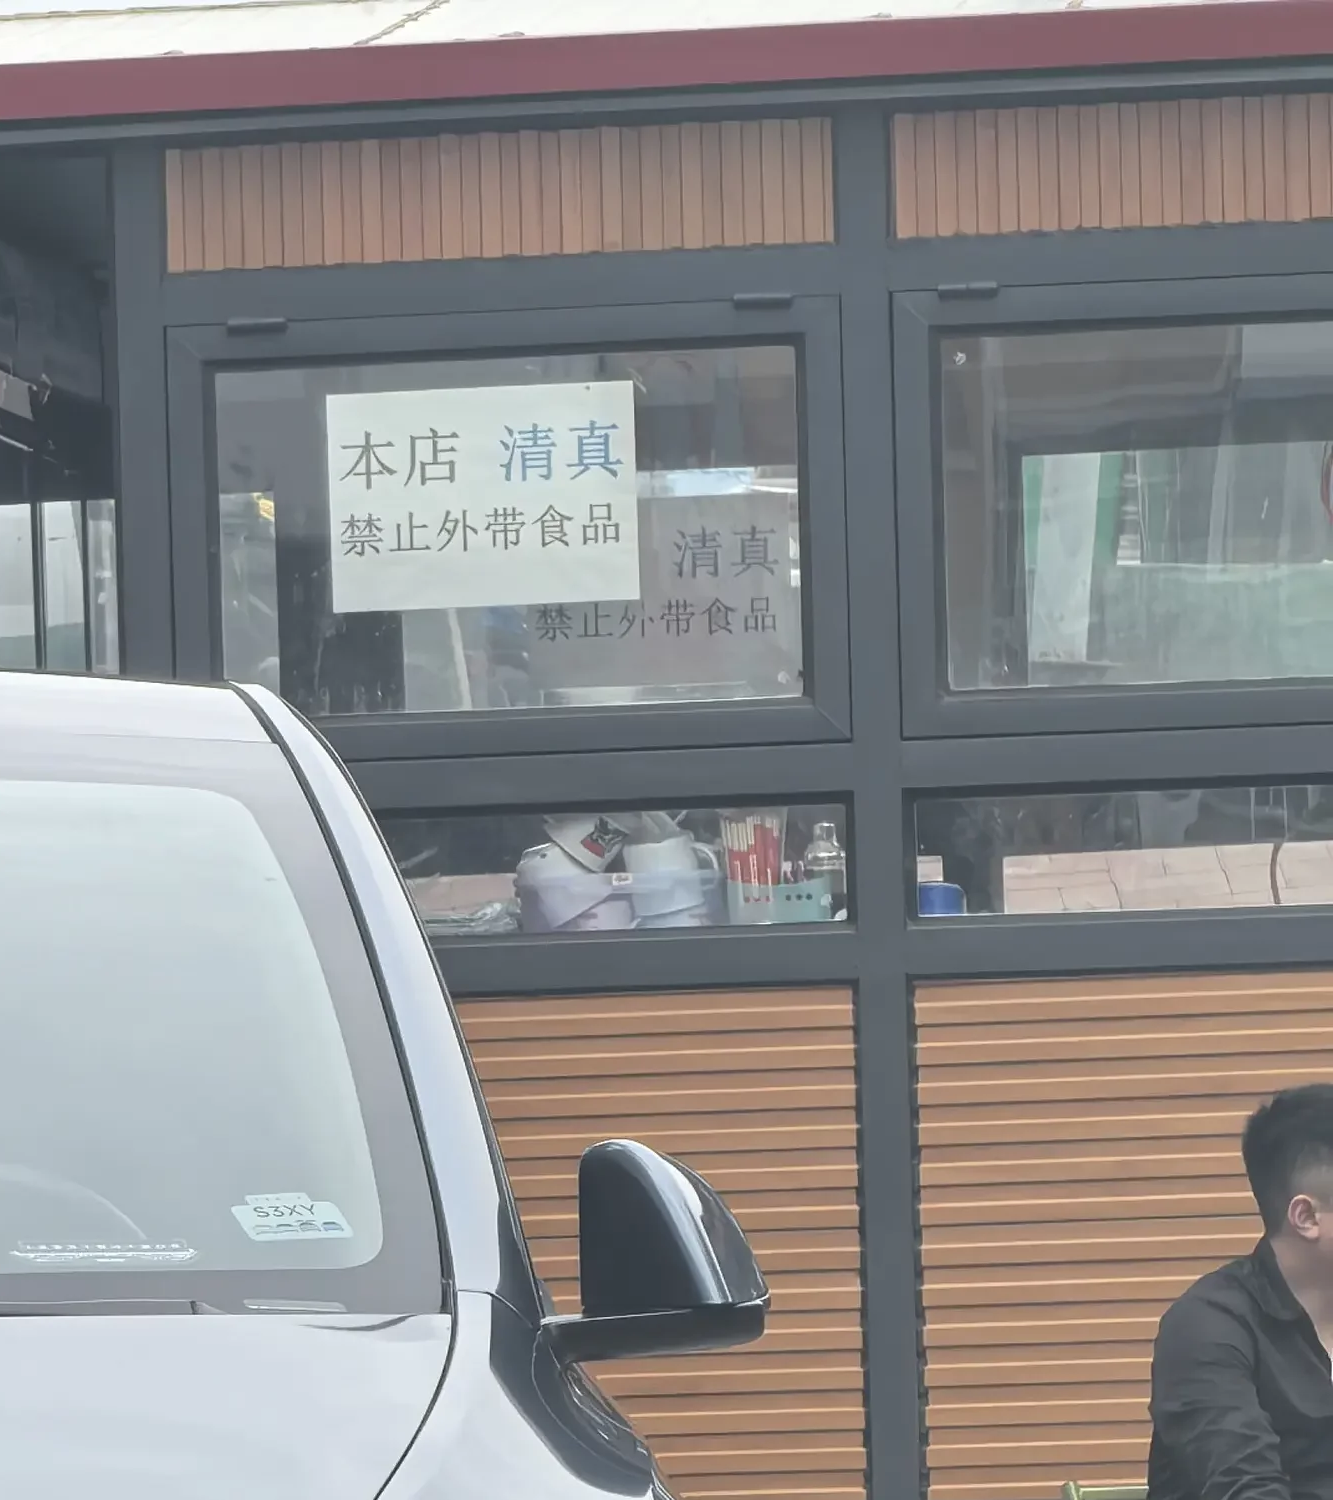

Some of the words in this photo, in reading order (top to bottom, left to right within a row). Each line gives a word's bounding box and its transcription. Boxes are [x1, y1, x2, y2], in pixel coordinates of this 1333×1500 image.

[338, 427, 461, 491] 本店
[498, 419, 624, 482] 清真
[339, 502, 621, 557] 禁止外带食品
[672, 524, 780, 579] 清真
[534, 596, 778, 642] 禁止外带食品
[252, 1203, 315, 1218] S3XY
